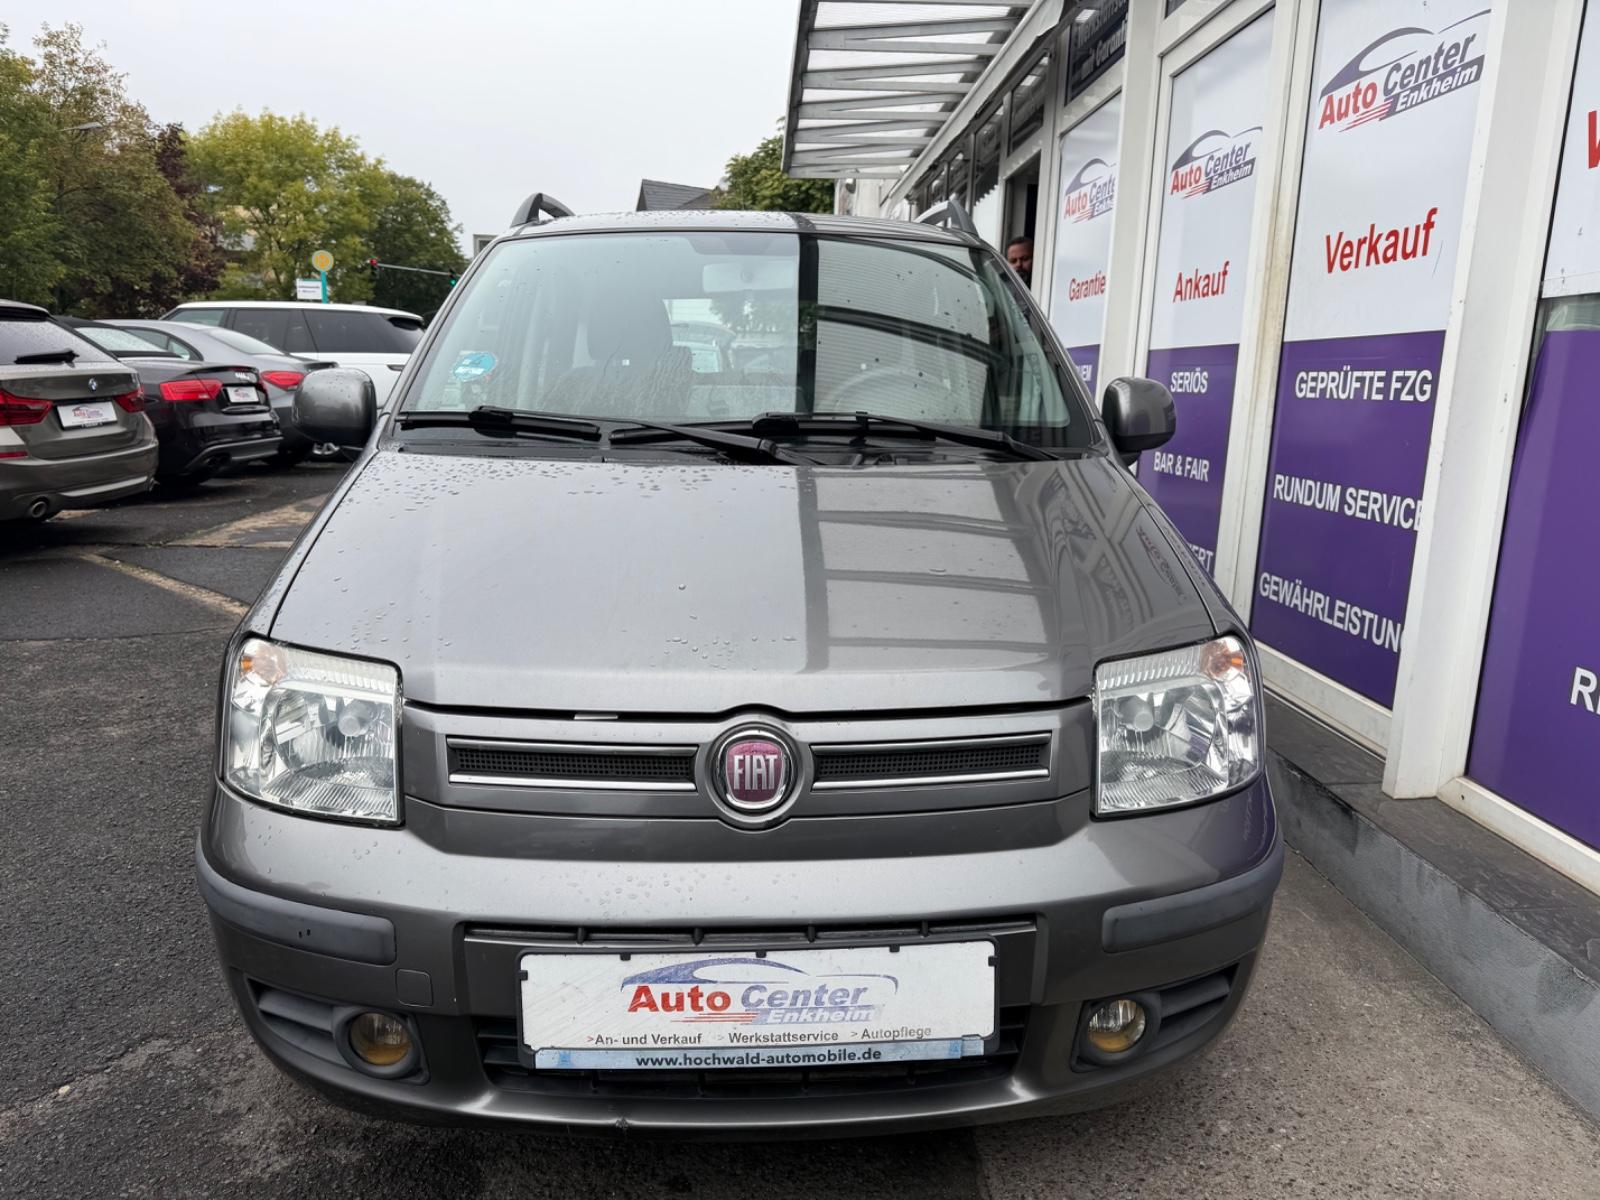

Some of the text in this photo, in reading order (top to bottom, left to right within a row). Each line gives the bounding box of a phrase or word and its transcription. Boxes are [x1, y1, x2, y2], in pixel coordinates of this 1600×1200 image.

[1318, 32, 1477, 130] Auto Center
[1395, 63, 1479, 113] Enkheim
[1170, 141, 1252, 196] Auto Center
[1211, 162, 1251, 188] Enkheim
[1063, 189, 1088, 219] Auto
[1325, 207, 1438, 275] Verkauf
[1068, 269, 1105, 301] Garantie
[1172, 260, 1230, 303] Ankauf
[1170, 367, 1209, 393] SERIÖS
[1295, 365, 1433, 402] GEPRÜFTE FZG
[1153, 451, 1210, 482] BAR & FAIR
[1273, 474, 1342, 513] RUNDUM
[1259, 572, 1402, 653] GEWÄHRLEISTUN
[1570, 666, 1600, 716] R
[733, 754, 778, 791] FIAT
[628, 983, 868, 1013] Auto Center
[766, 1008, 875, 1024] Enkheim
[622, 1033, 651, 1045] und
[651, 1033, 703, 1045] Verkauf
[728, 1030, 839, 1044] Werkstattservice
[861, 1026, 932, 1041] Autopflege
[636, 1049, 882, 1066] www.hochwald-automobile.de
